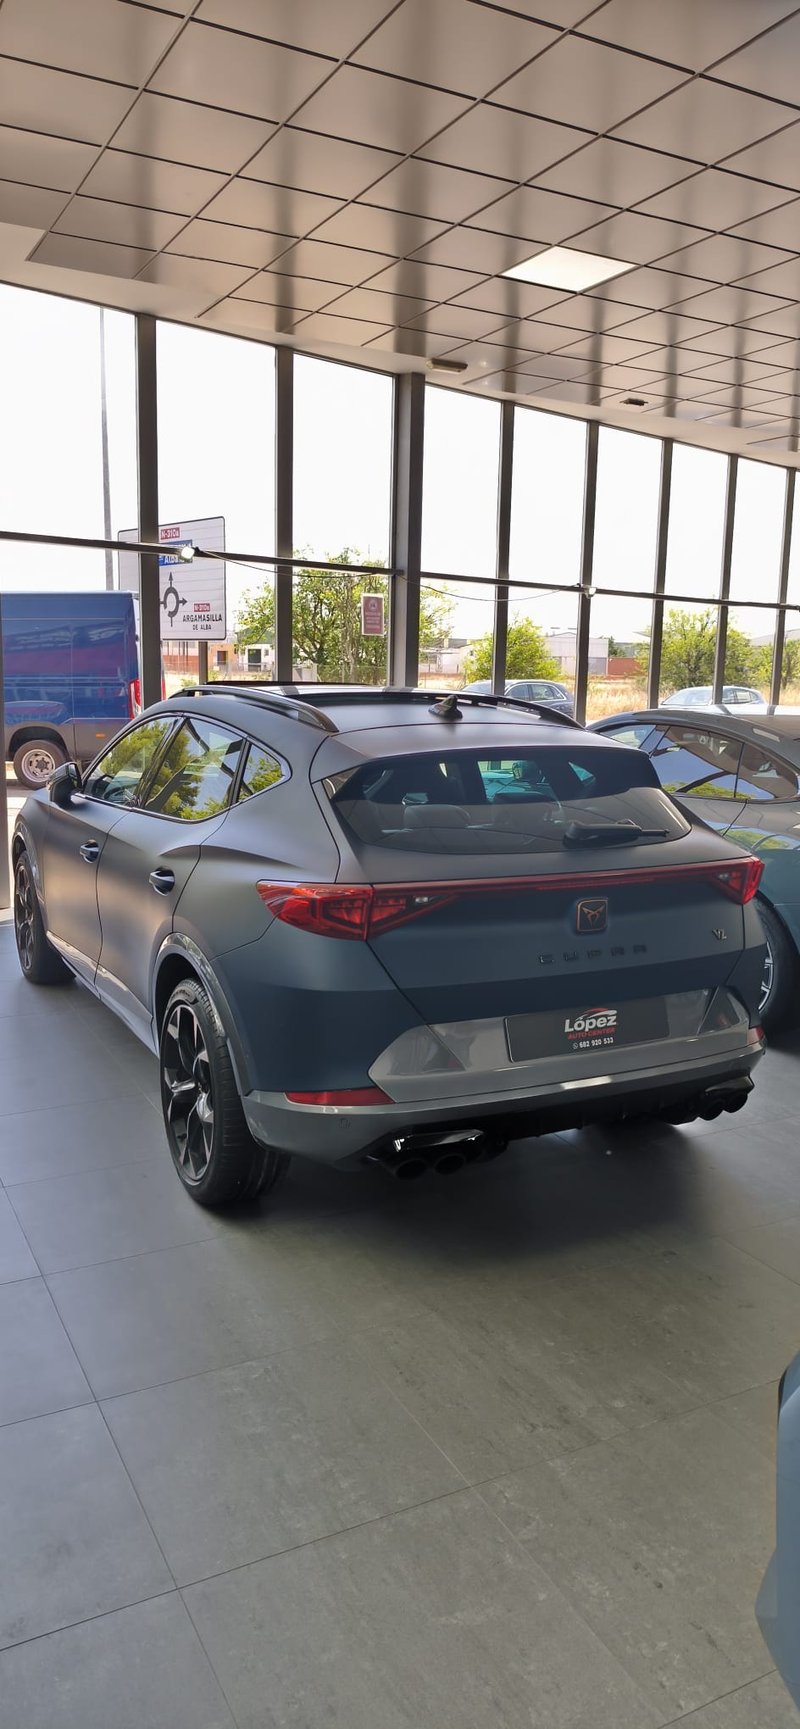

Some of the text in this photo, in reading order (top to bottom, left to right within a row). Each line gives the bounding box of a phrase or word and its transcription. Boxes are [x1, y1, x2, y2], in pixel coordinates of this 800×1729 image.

[183, 614, 222, 622] ARGAMASILLA
[538, 944, 647, 964] CUPRA
[564, 1015, 617, 1032] López
[567, 1026, 616, 1040] AUTO CENTER
[579, 1040, 590, 1048] 682
[591, 1038, 602, 1046] 920
